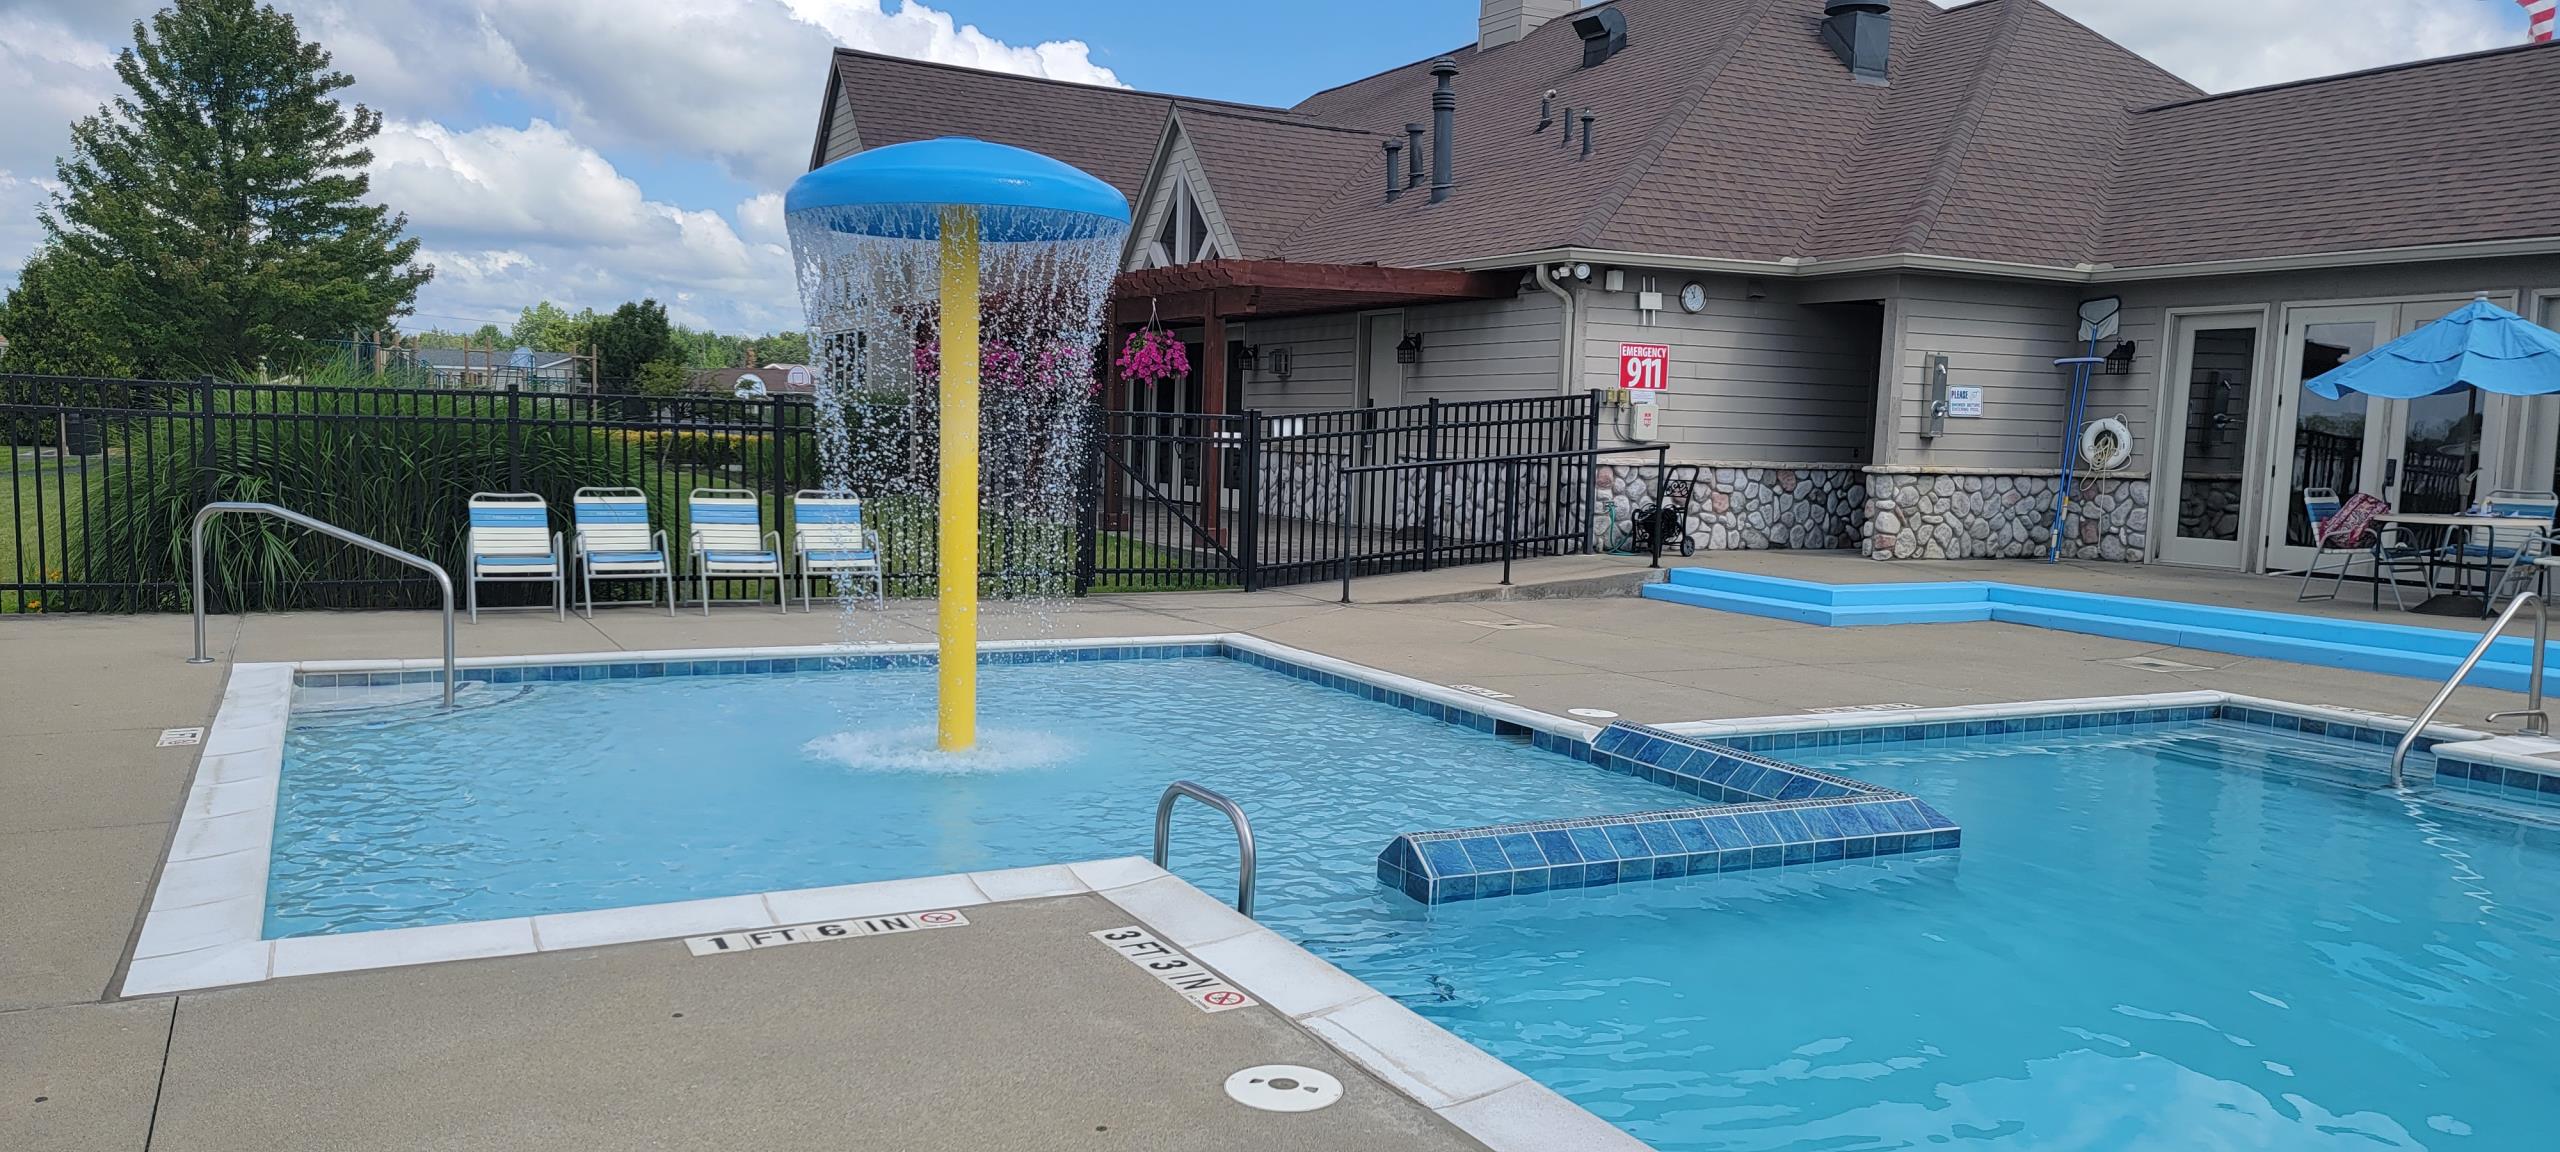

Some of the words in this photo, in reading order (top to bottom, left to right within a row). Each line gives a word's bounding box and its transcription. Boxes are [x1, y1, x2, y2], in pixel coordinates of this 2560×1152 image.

[1622, 346, 1667, 358] EMERGENCY
[1627, 357, 1662, 388] 911
[1951, 390, 1968, 399] PLEASE
[708, 936, 730, 950] 1
[749, 928, 798, 945] FT
[817, 924, 847, 937] 6
[863, 916, 909, 933] IN
[1104, 930, 1142, 941] 3
[1119, 941, 1171, 957] FT
[1149, 959, 1189, 970] 3
[1167, 972, 1221, 991] IN
